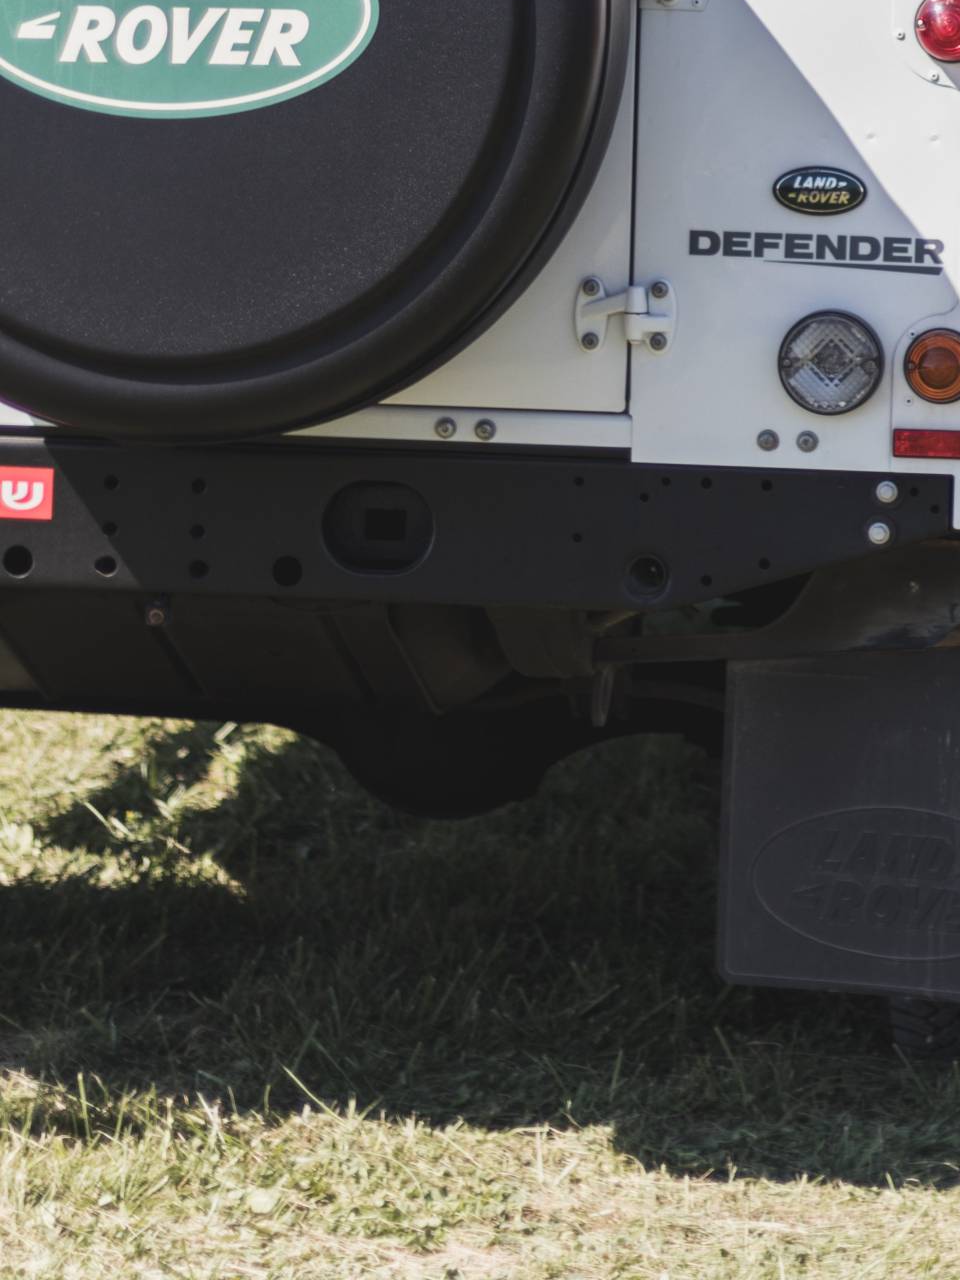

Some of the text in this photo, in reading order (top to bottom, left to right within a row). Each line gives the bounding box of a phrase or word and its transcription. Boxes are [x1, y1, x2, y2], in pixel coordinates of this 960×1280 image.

[58, 4, 310, 66] ROVER
[797, 191, 850, 204] ROVER
[688, 229, 945, 265] DEFENDER
